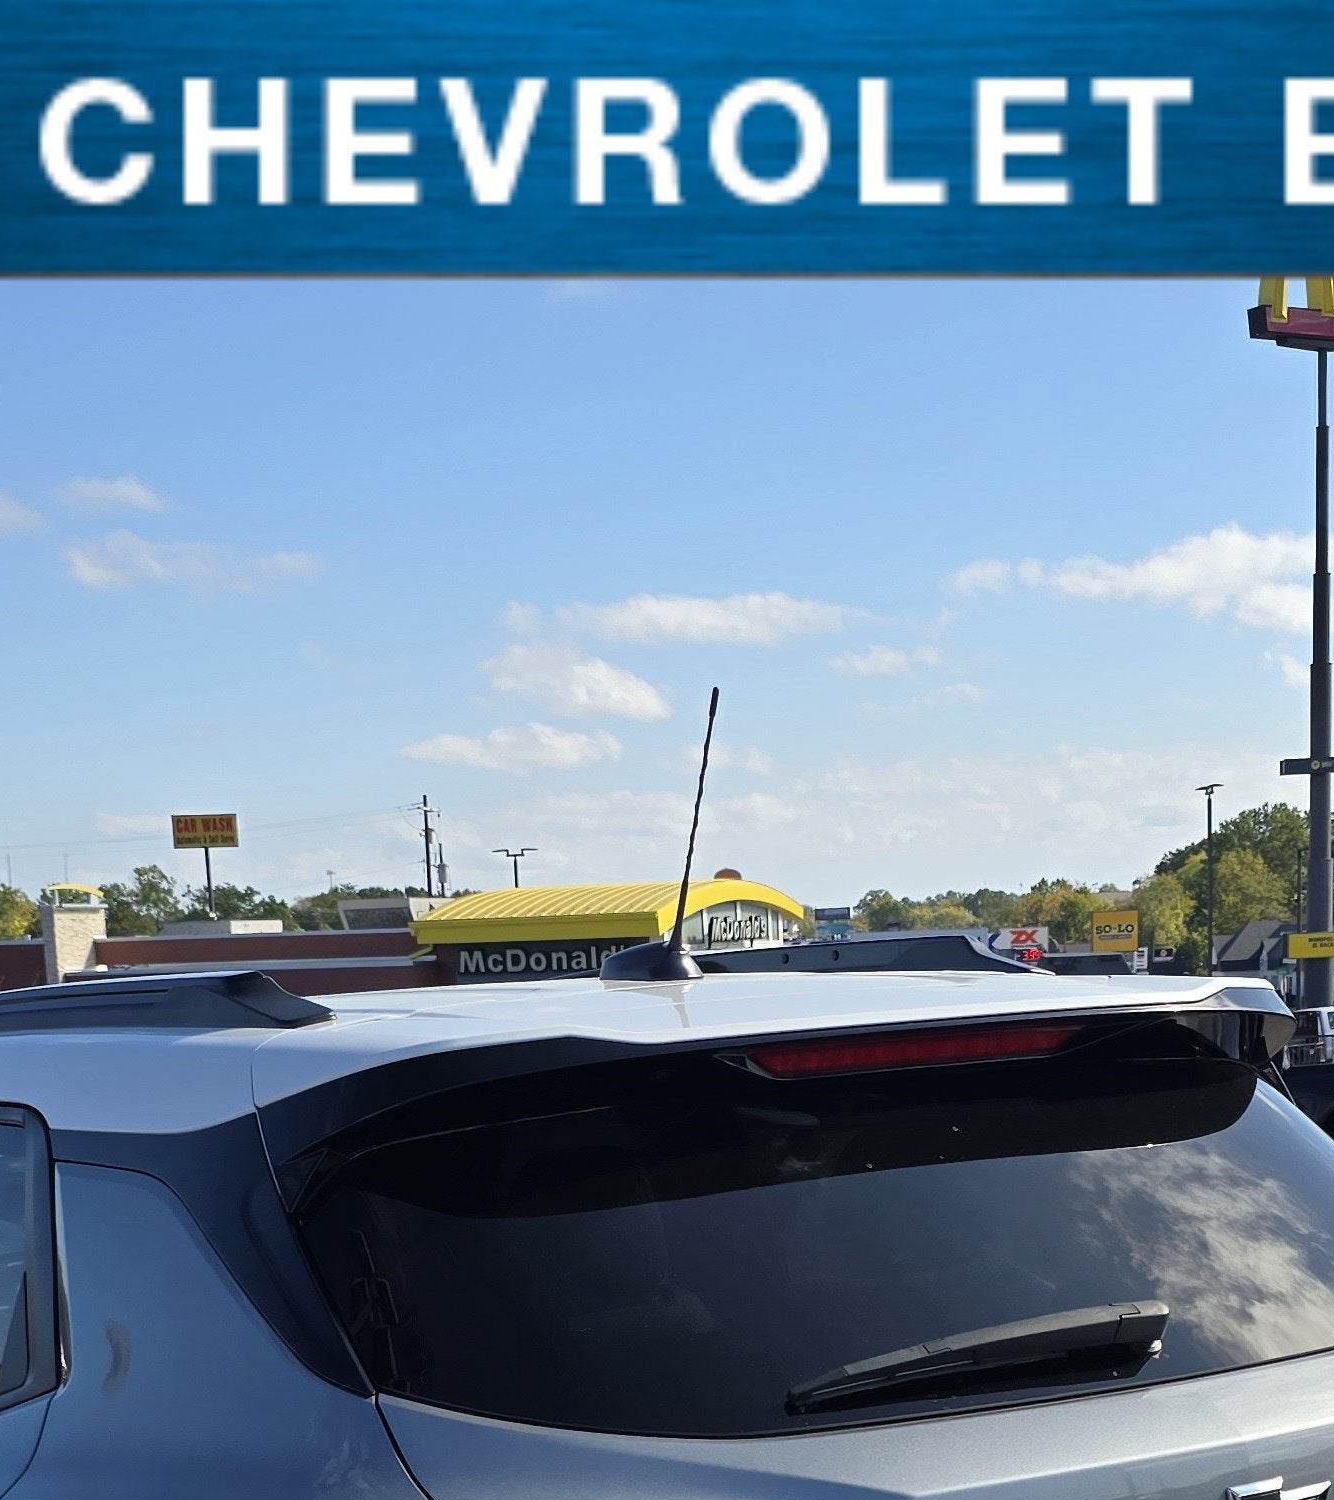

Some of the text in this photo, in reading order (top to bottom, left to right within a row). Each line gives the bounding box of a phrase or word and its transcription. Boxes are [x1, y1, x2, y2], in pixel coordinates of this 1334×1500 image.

[176, 817, 233, 834] CAR WASH
[710, 915, 767, 943] McDonald's
[1009, 929, 1039, 944] ZX
[1095, 924, 1135, 935] SO-LO
